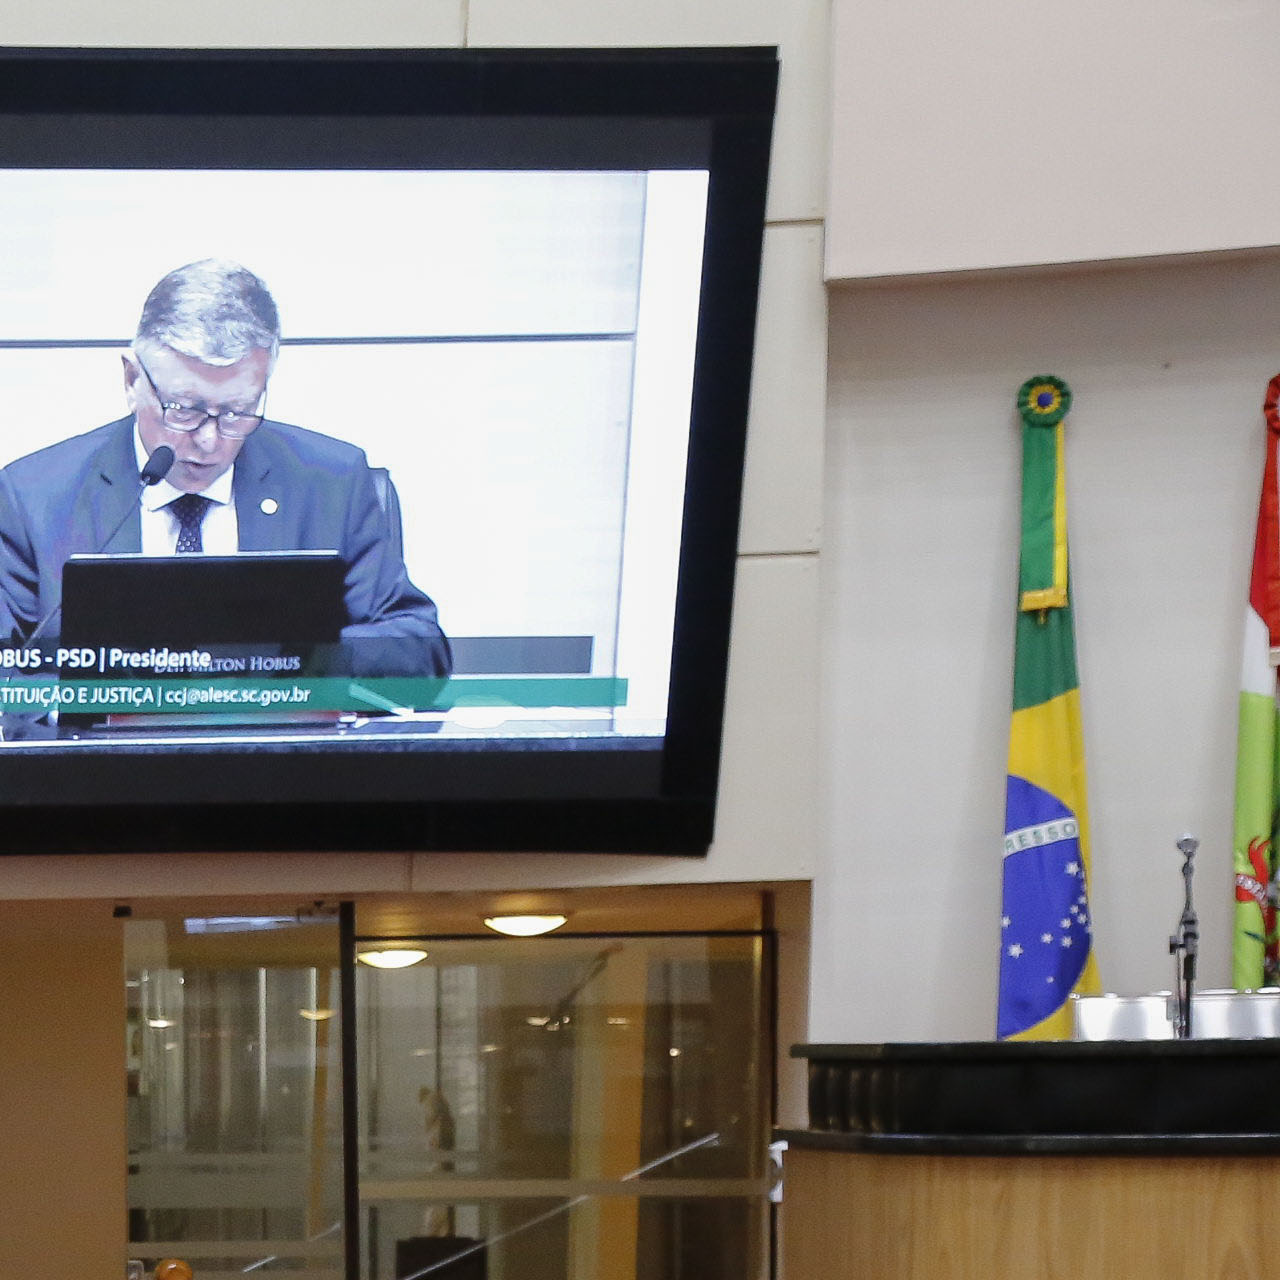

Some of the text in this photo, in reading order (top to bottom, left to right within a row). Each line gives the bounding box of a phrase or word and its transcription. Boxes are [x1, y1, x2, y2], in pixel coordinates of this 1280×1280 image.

[56, 649, 96, 668] PSD
[109, 648, 211, 668] Presidente
[249, 656, 301, 671] HOBUS
[78, 687, 87, 703] E
[89, 687, 154, 707] JUSTIÇA
[165, 686, 311, 707] ccj@alesc.sc.gov.br
